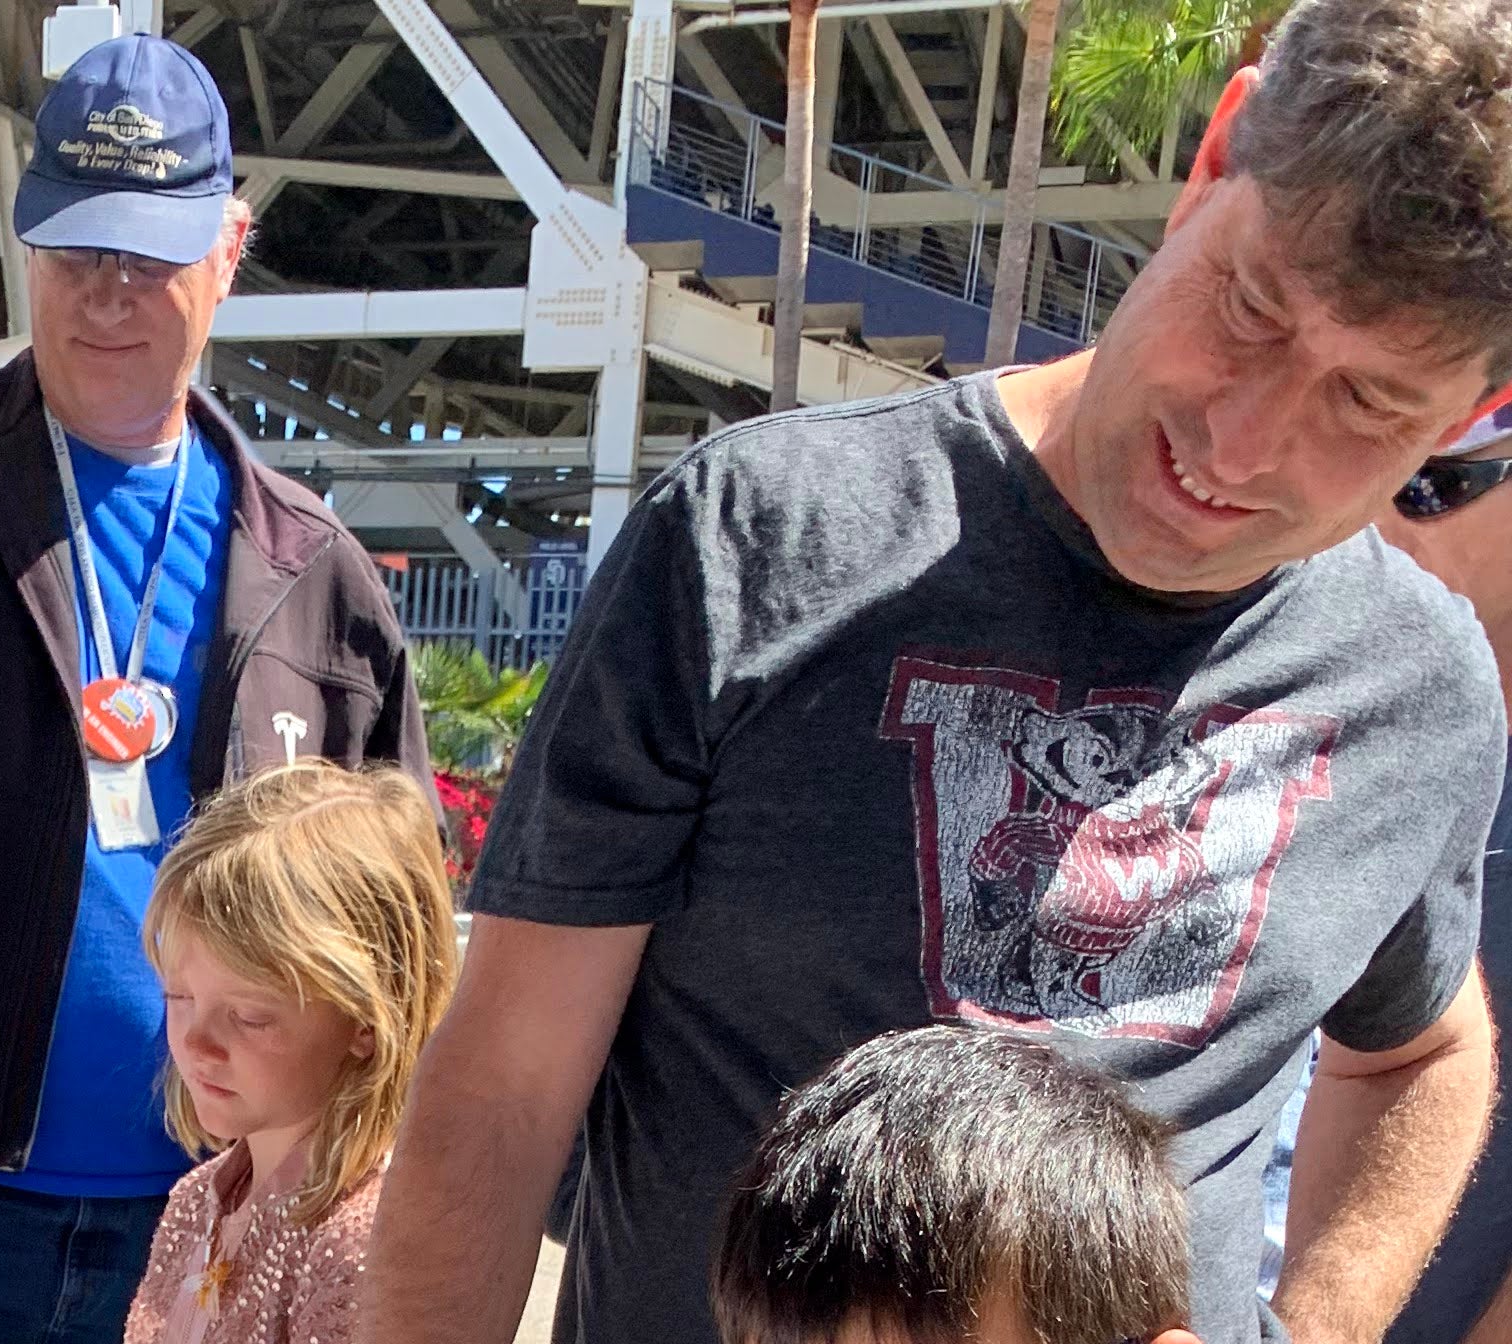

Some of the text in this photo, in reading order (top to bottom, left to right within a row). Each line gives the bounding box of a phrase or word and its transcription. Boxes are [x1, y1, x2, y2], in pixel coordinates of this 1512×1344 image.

[58, 139, 93, 156] Quality,
[95, 141, 128, 158] Value,
[90, 156, 119, 171] Every
[123, 161, 155, 176] Drop!
